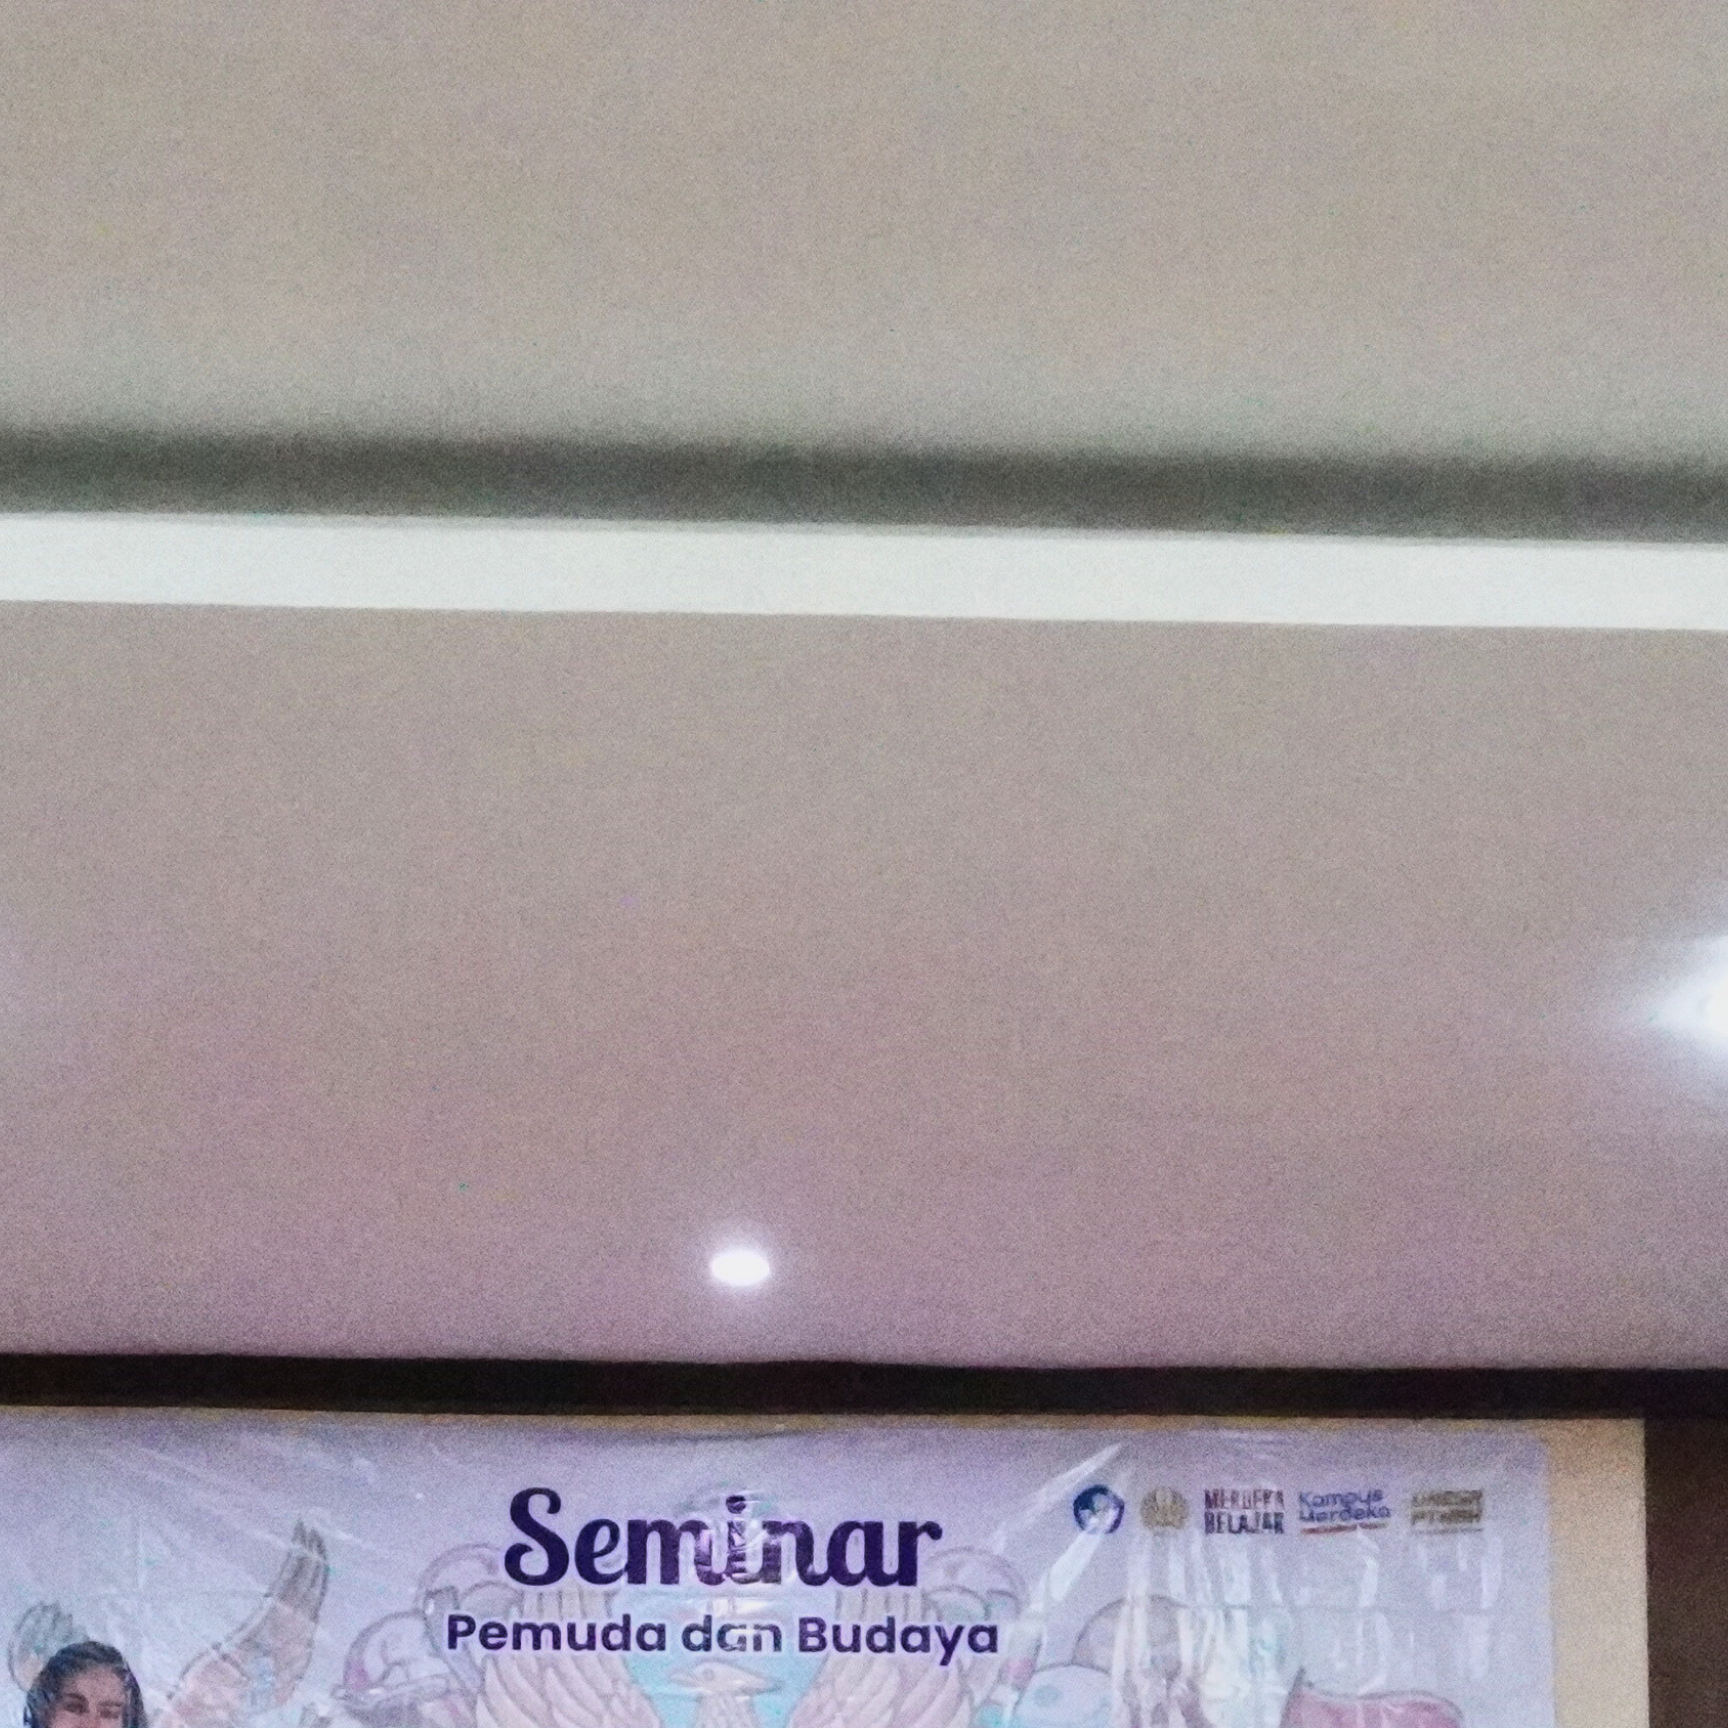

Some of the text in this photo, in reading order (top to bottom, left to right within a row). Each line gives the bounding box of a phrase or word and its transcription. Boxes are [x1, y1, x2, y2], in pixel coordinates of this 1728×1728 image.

[503, 1487, 943, 1587] Seminar
[447, 1614, 998, 1666] Pemuda dan Budaya
